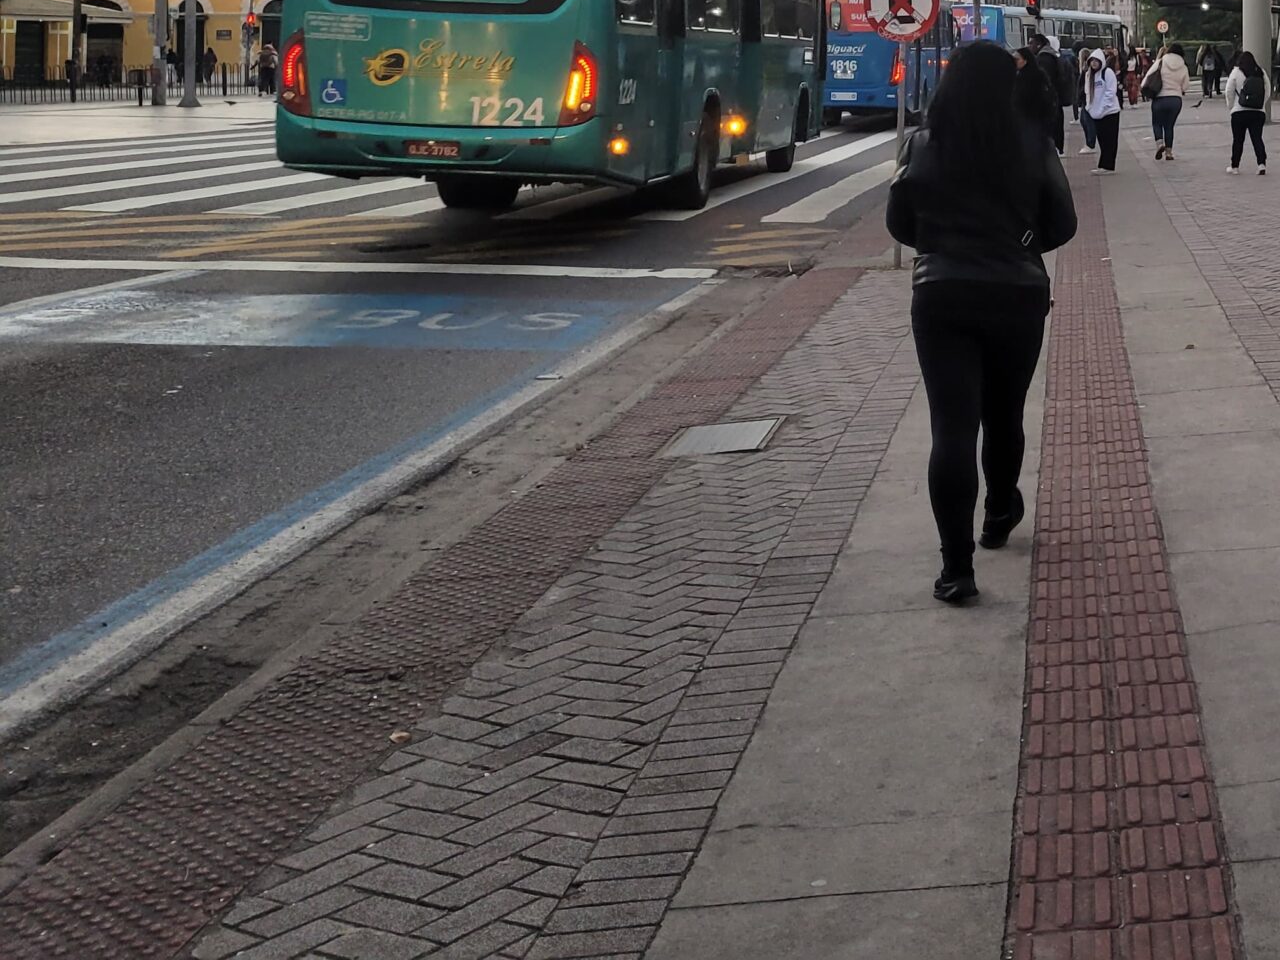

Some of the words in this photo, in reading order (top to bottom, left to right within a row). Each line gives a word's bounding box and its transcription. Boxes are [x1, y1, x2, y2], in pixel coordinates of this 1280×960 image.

[413, 38, 518, 73] Estrela
[830, 59, 858, 72] 1816
[469, 95, 545, 127] 1224
